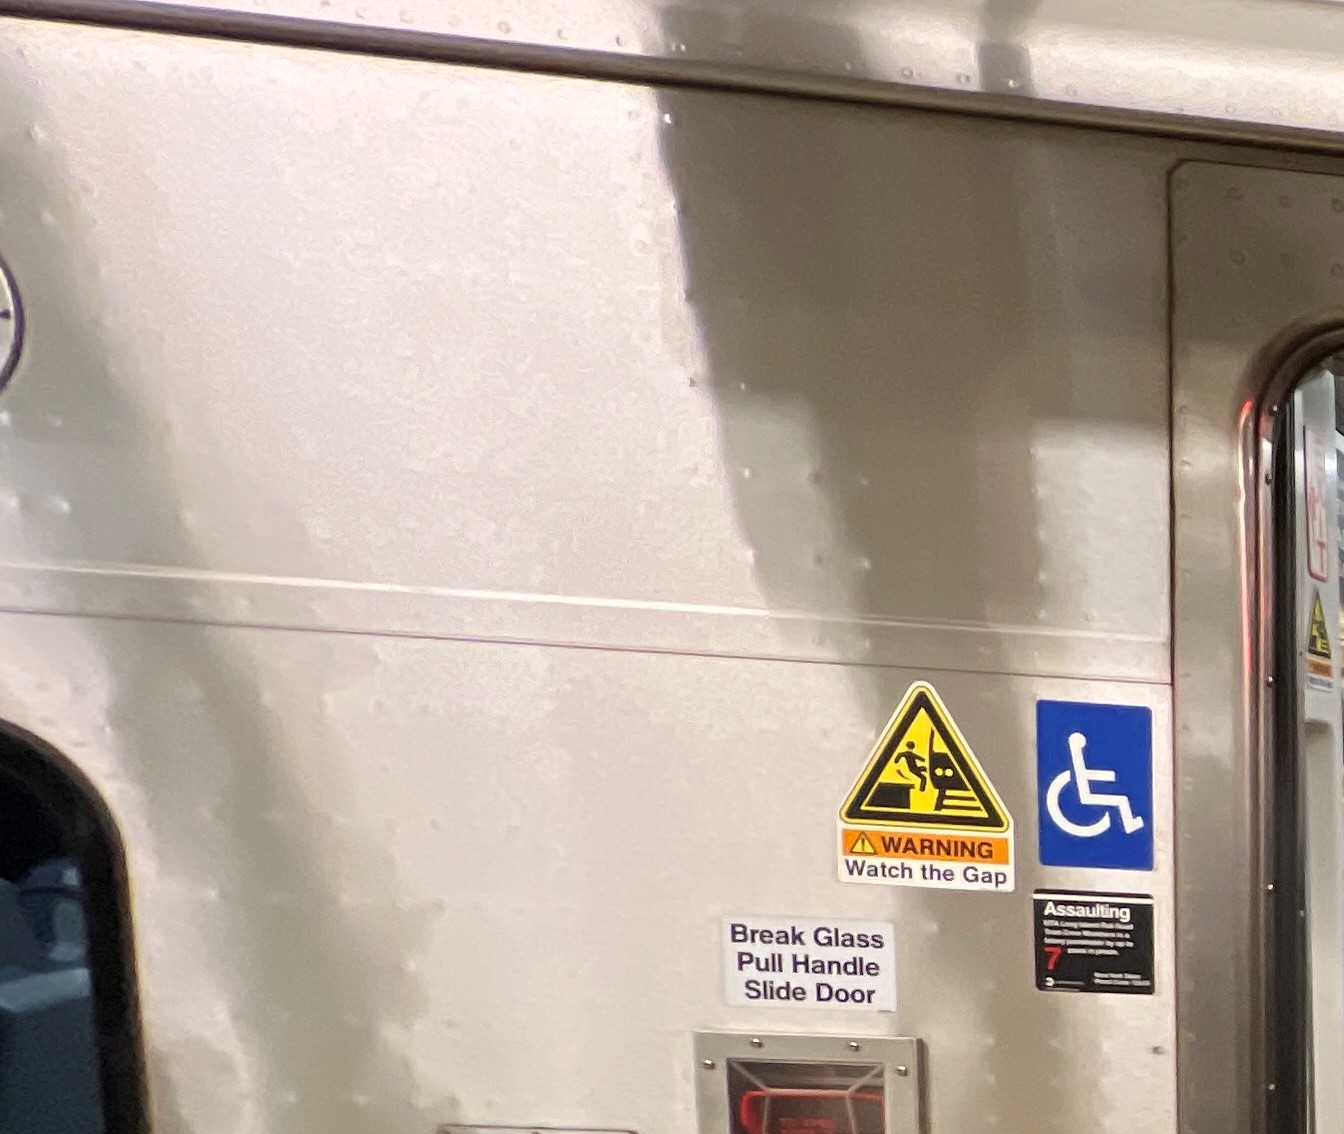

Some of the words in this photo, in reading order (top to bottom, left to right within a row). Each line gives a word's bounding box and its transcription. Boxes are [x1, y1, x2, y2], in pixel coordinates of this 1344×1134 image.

[881, 835, 993, 859] WARNING
[845, 858, 913, 880] Watch
[920, 863, 955, 882] the
[962, 865, 1008, 888] Gap
[1043, 901, 1131, 923] Assaulting
[730, 923, 806, 946] Break
[813, 926, 885, 949] Glass
[737, 951, 783, 973] Pull
[792, 953, 880, 977] Handle
[1043, 946, 1063, 971] 7
[744, 979, 807, 1001] Slide
[815, 982, 876, 1004] Door
